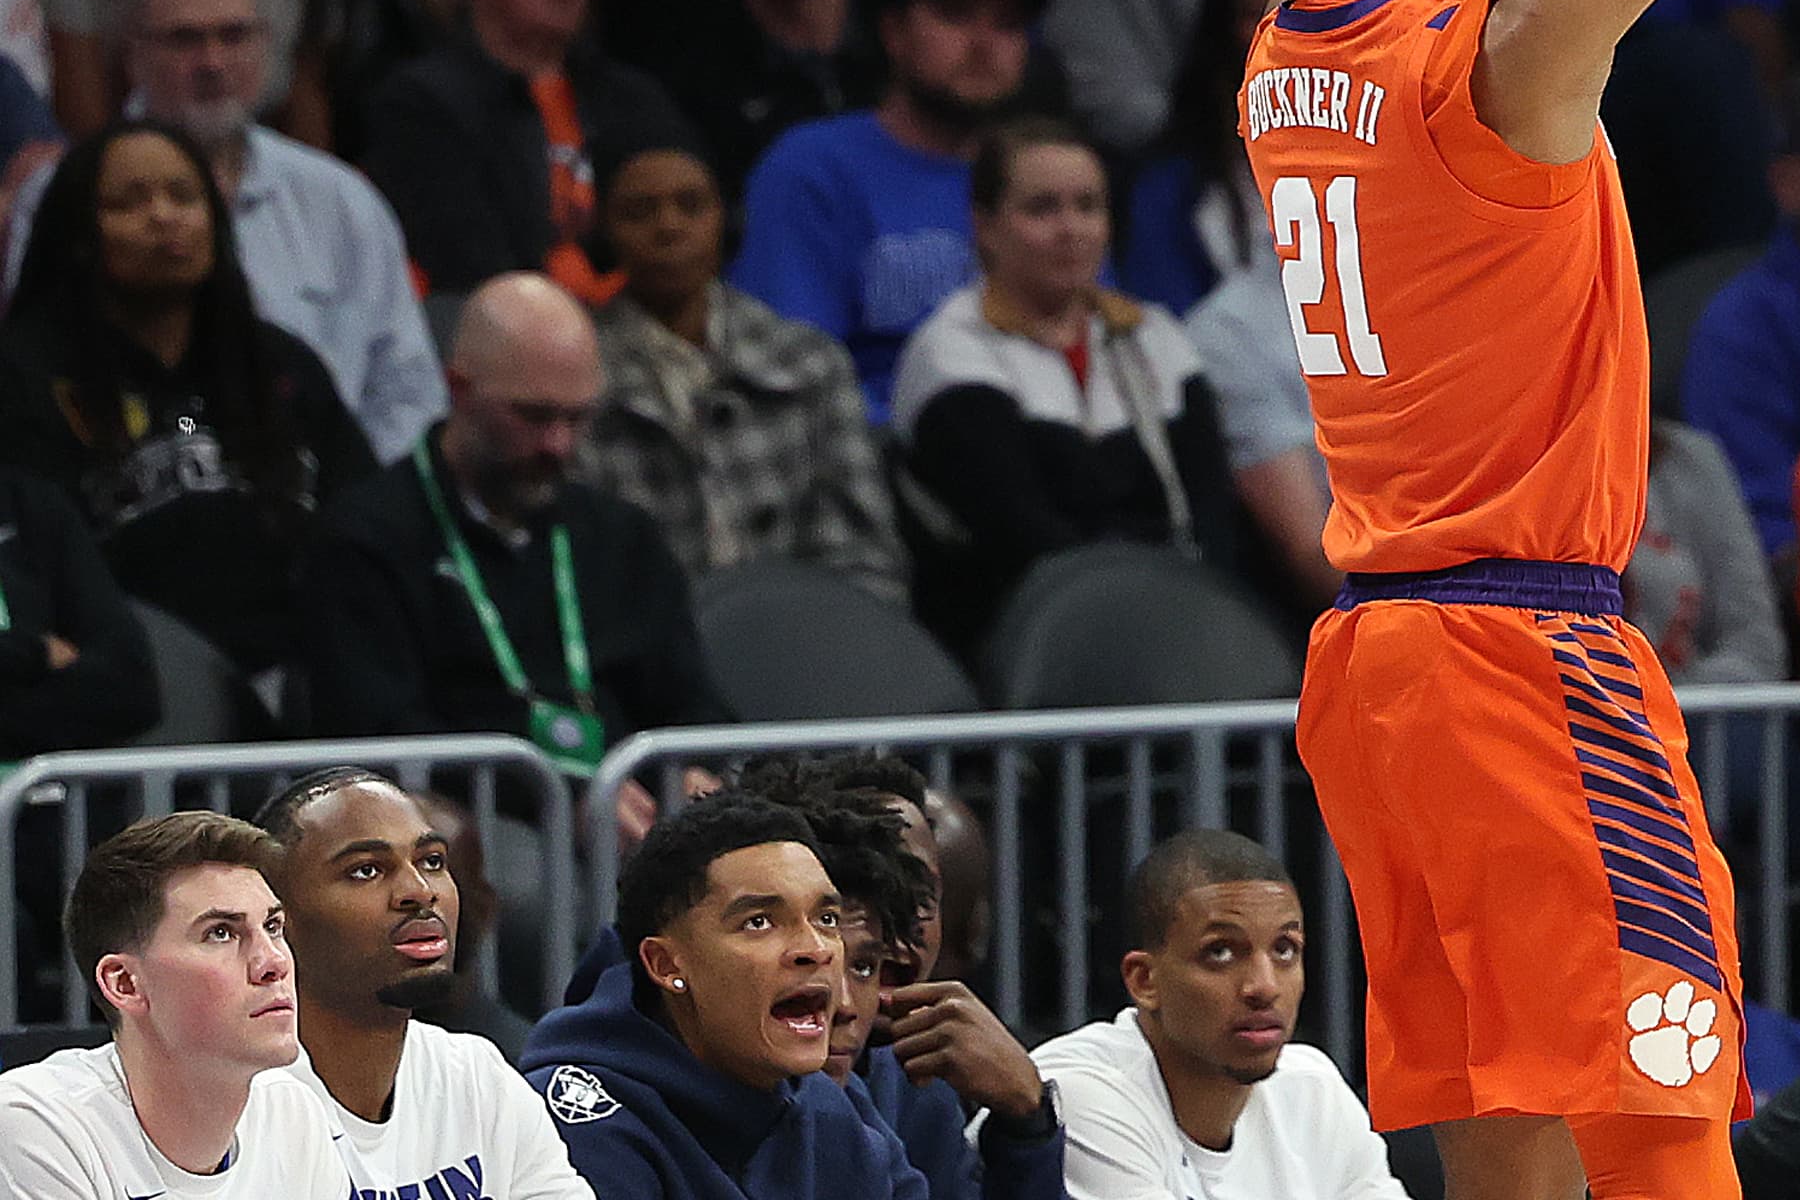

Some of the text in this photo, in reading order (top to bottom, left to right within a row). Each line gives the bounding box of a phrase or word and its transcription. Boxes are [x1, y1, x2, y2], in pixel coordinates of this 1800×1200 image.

[1247, 67, 1386, 145] BUCKNER II
[1272, 176, 1389, 377] 21
